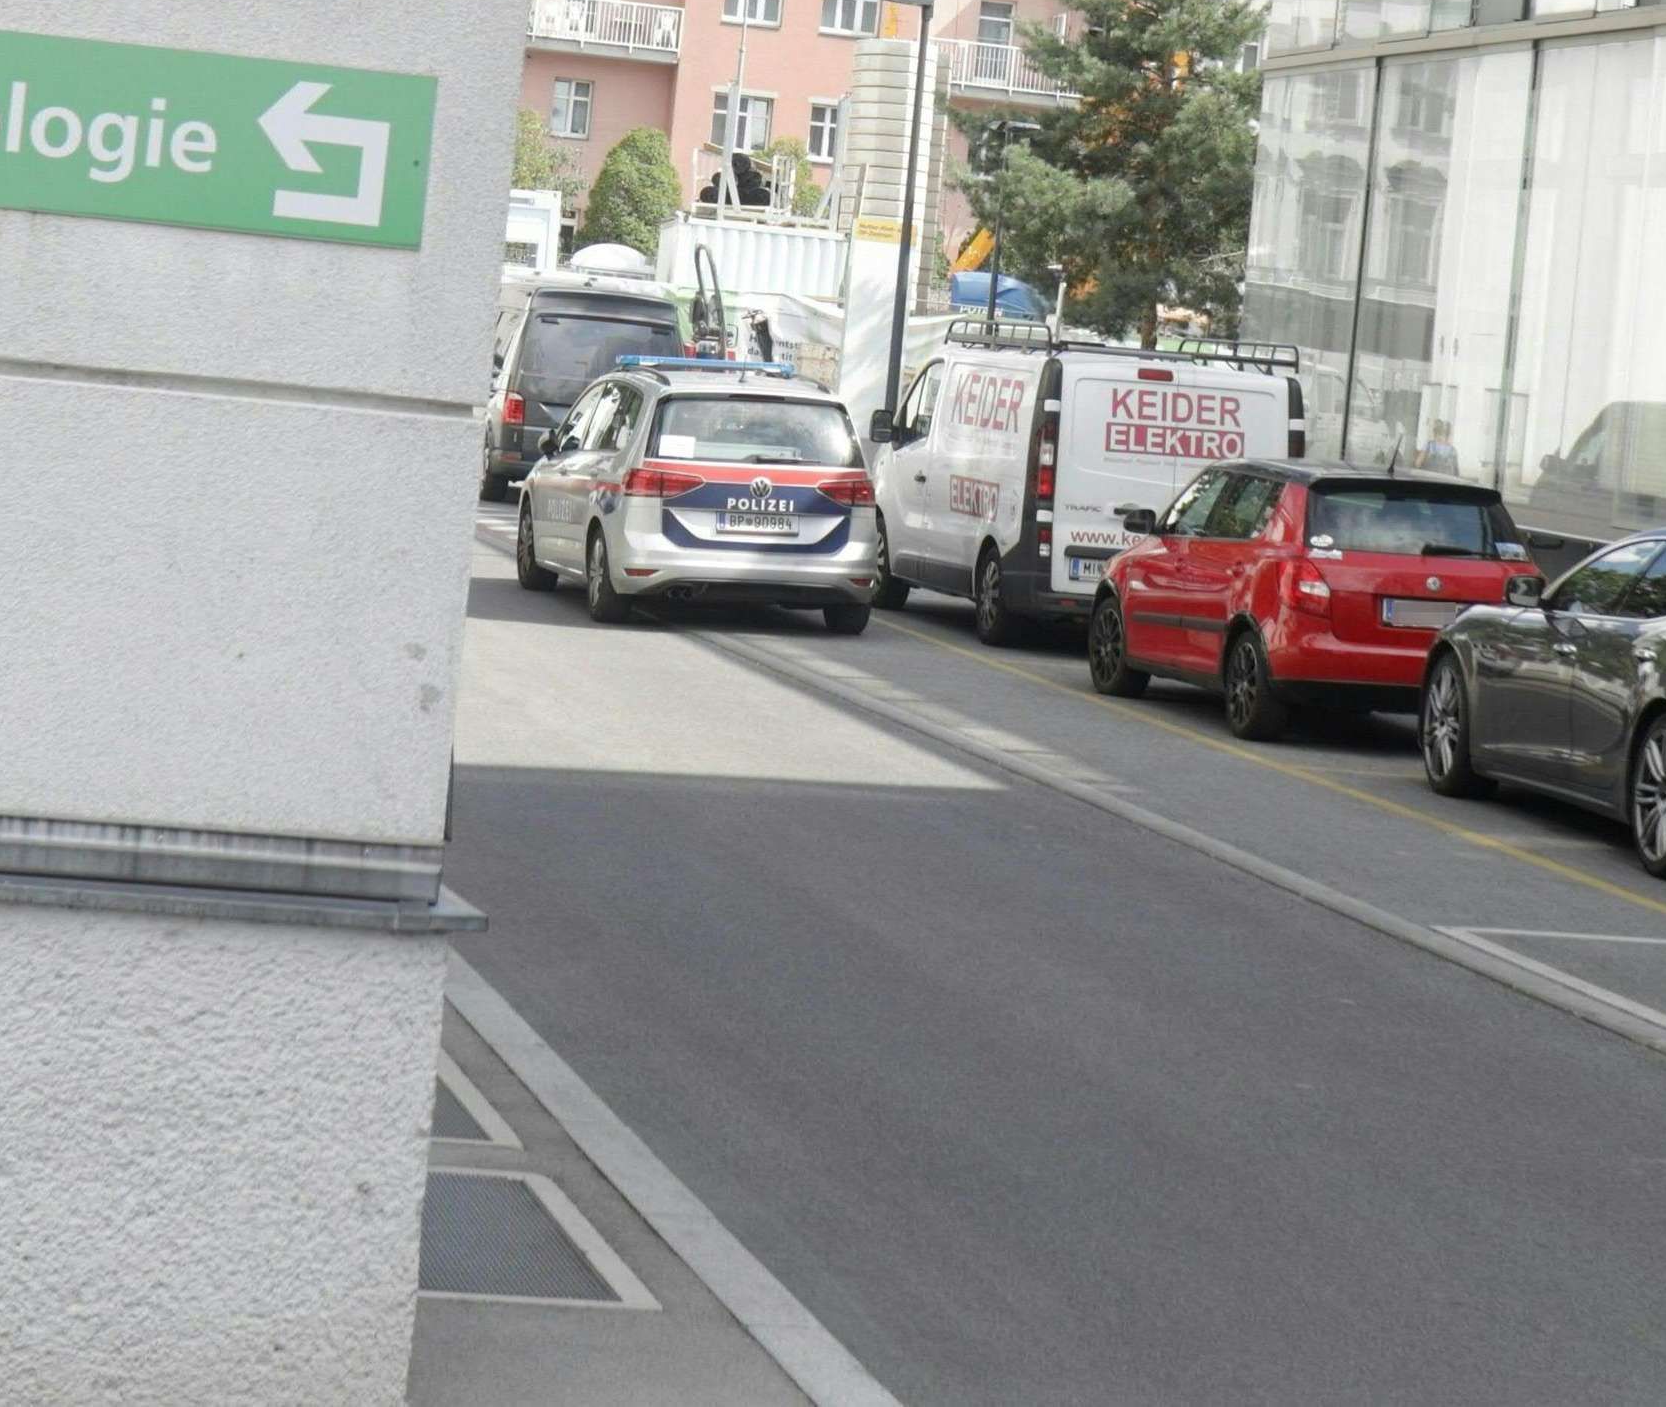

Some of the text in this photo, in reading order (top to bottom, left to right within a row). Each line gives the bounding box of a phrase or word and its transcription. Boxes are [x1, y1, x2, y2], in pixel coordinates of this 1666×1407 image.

[951, 372, 1025, 433] KEIDER
[1111, 387, 1242, 428] KEIDER
[1109, 424, 1242, 460] ELEKTRO
[726, 497, 795, 512] POLIZEI
[950, 476, 999, 522] ELEKTRO
[1064, 503, 1102, 513] TRAFIC
[1070, 530, 1142, 547] www.ke
